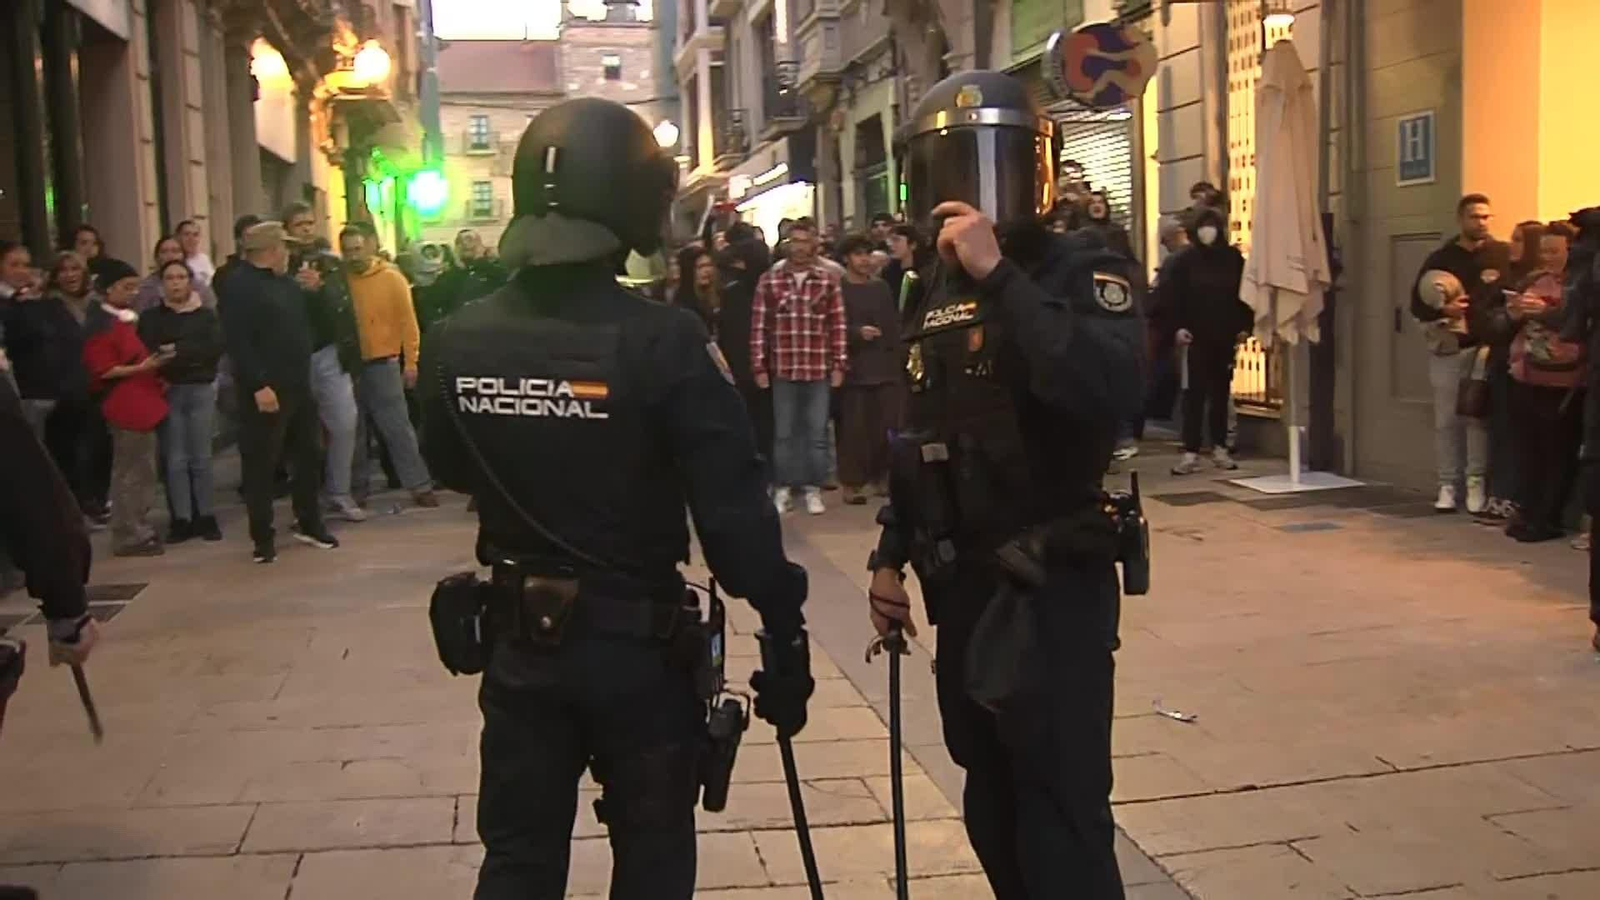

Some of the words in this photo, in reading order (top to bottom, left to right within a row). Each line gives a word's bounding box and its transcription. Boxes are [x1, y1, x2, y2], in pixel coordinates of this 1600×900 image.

[1405, 120, 1426, 162] H
[456, 377, 574, 398] POLICIA
[458, 396, 609, 418] NACIONAL
